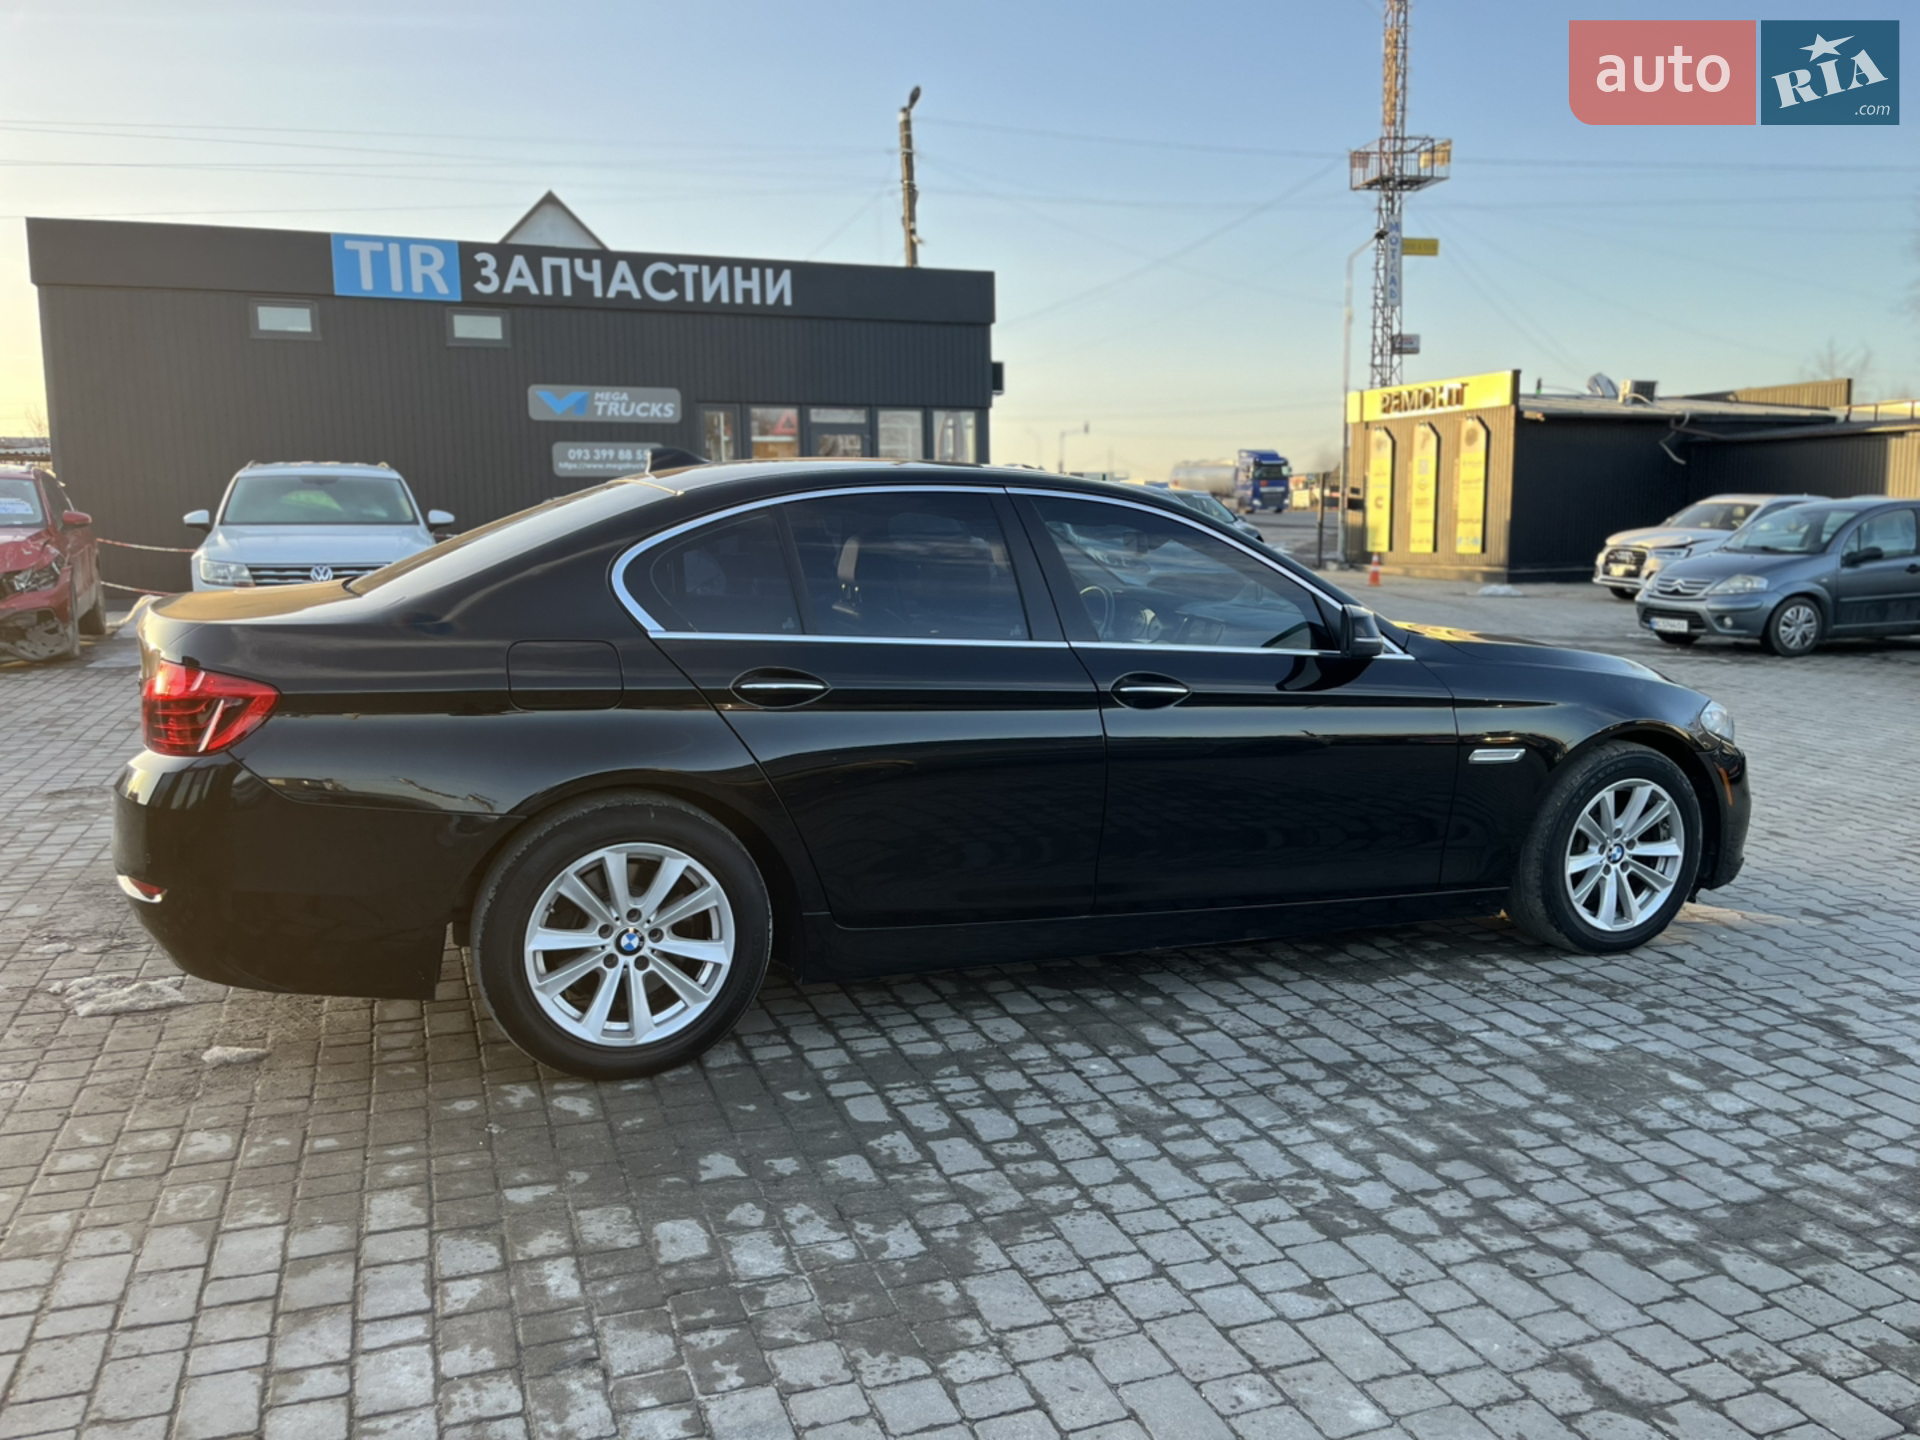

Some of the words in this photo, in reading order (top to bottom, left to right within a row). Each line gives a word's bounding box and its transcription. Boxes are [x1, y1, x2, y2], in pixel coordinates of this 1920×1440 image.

[344, 239, 450, 295] TIR
[473, 252, 793, 306] ЗАПЧАСТИНИ
[594, 391, 629, 401] MEGA
[1380, 384, 1465, 414] РЕМОНТ
[594, 401, 676, 418] TRUCKS
[567, 449, 591, 460] 093
[593, 449, 615, 460] 399
